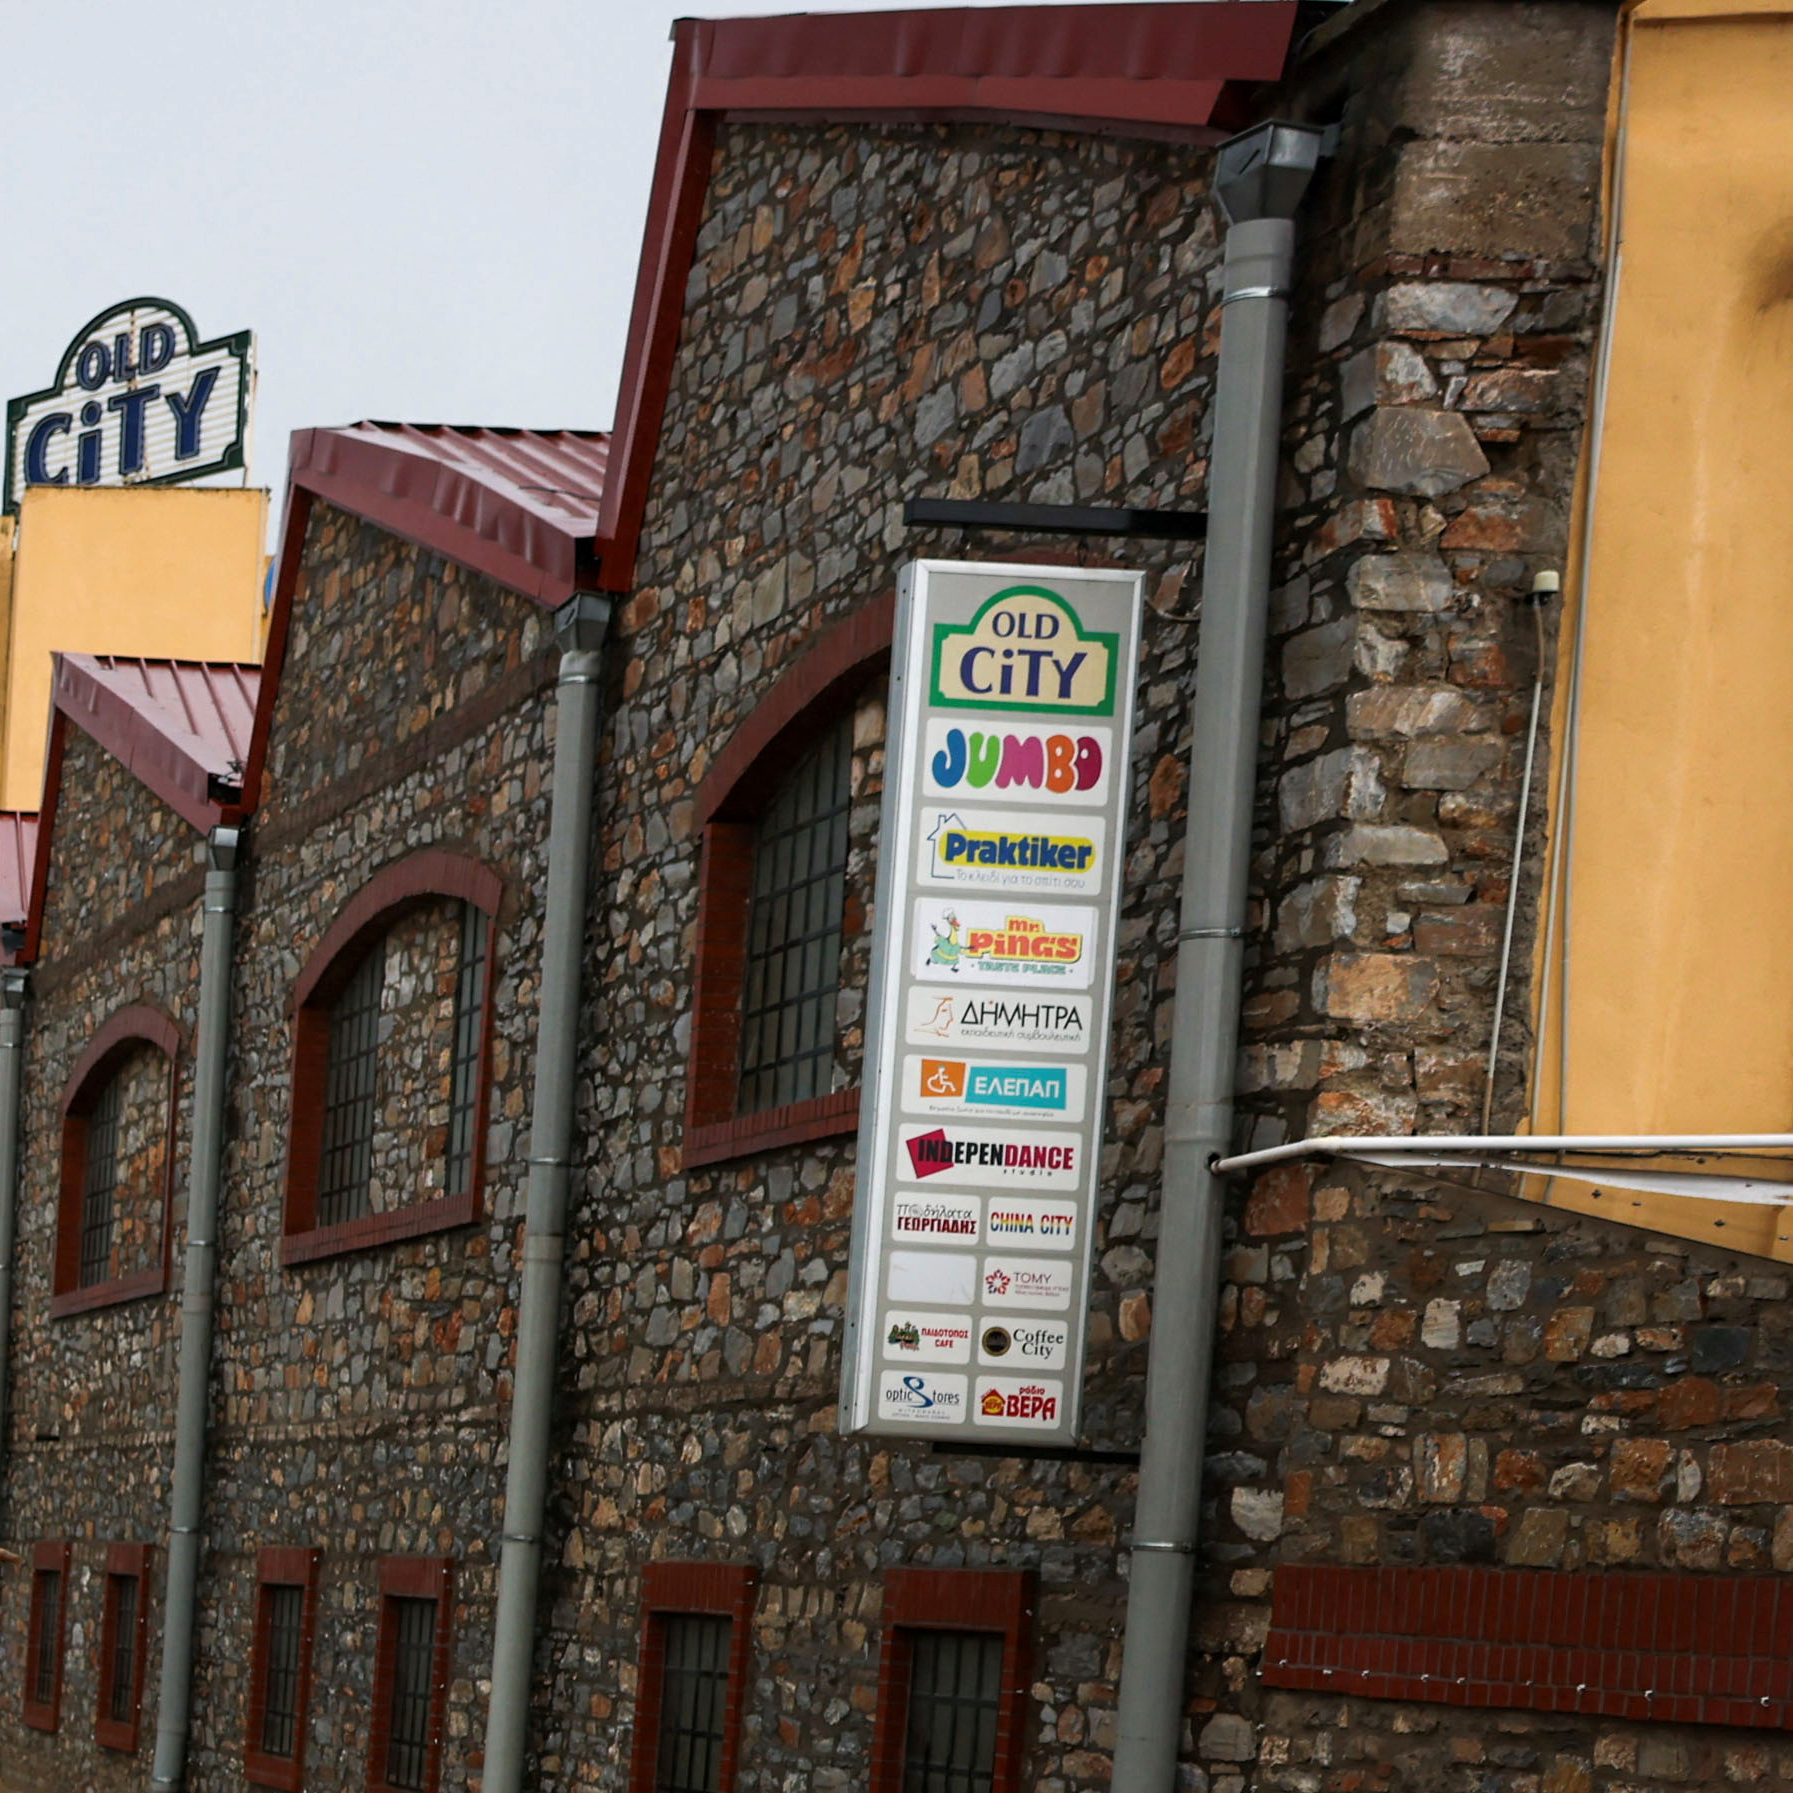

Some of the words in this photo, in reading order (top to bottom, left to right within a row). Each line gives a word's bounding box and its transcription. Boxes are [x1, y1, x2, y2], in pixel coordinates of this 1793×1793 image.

[76, 322, 176, 391] OLD
[992, 611, 1059, 639] OLD
[931, 728, 1103, 794] JUMBO
[945, 832, 1093, 869] Praktiker
[974, 1076, 1060, 1099] ΕΛΕΠΑΠ
[917, 1139, 1074, 1170] INDEPENDANCE
[897, 1216, 977, 1235] ΓΕΩΡΓΙΑΔΗΣ
[990, 1212, 1034, 1233] CHINA
[1040, 1214, 1073, 1235] CITY
[921, 1327, 969, 1339] ΠΑΙΔΟΤΟΠΟΣ
[935, 1339, 954, 1348] CAFE
[1013, 1328, 1064, 1345] Coffee
[1022, 1342, 1054, 1360] City
